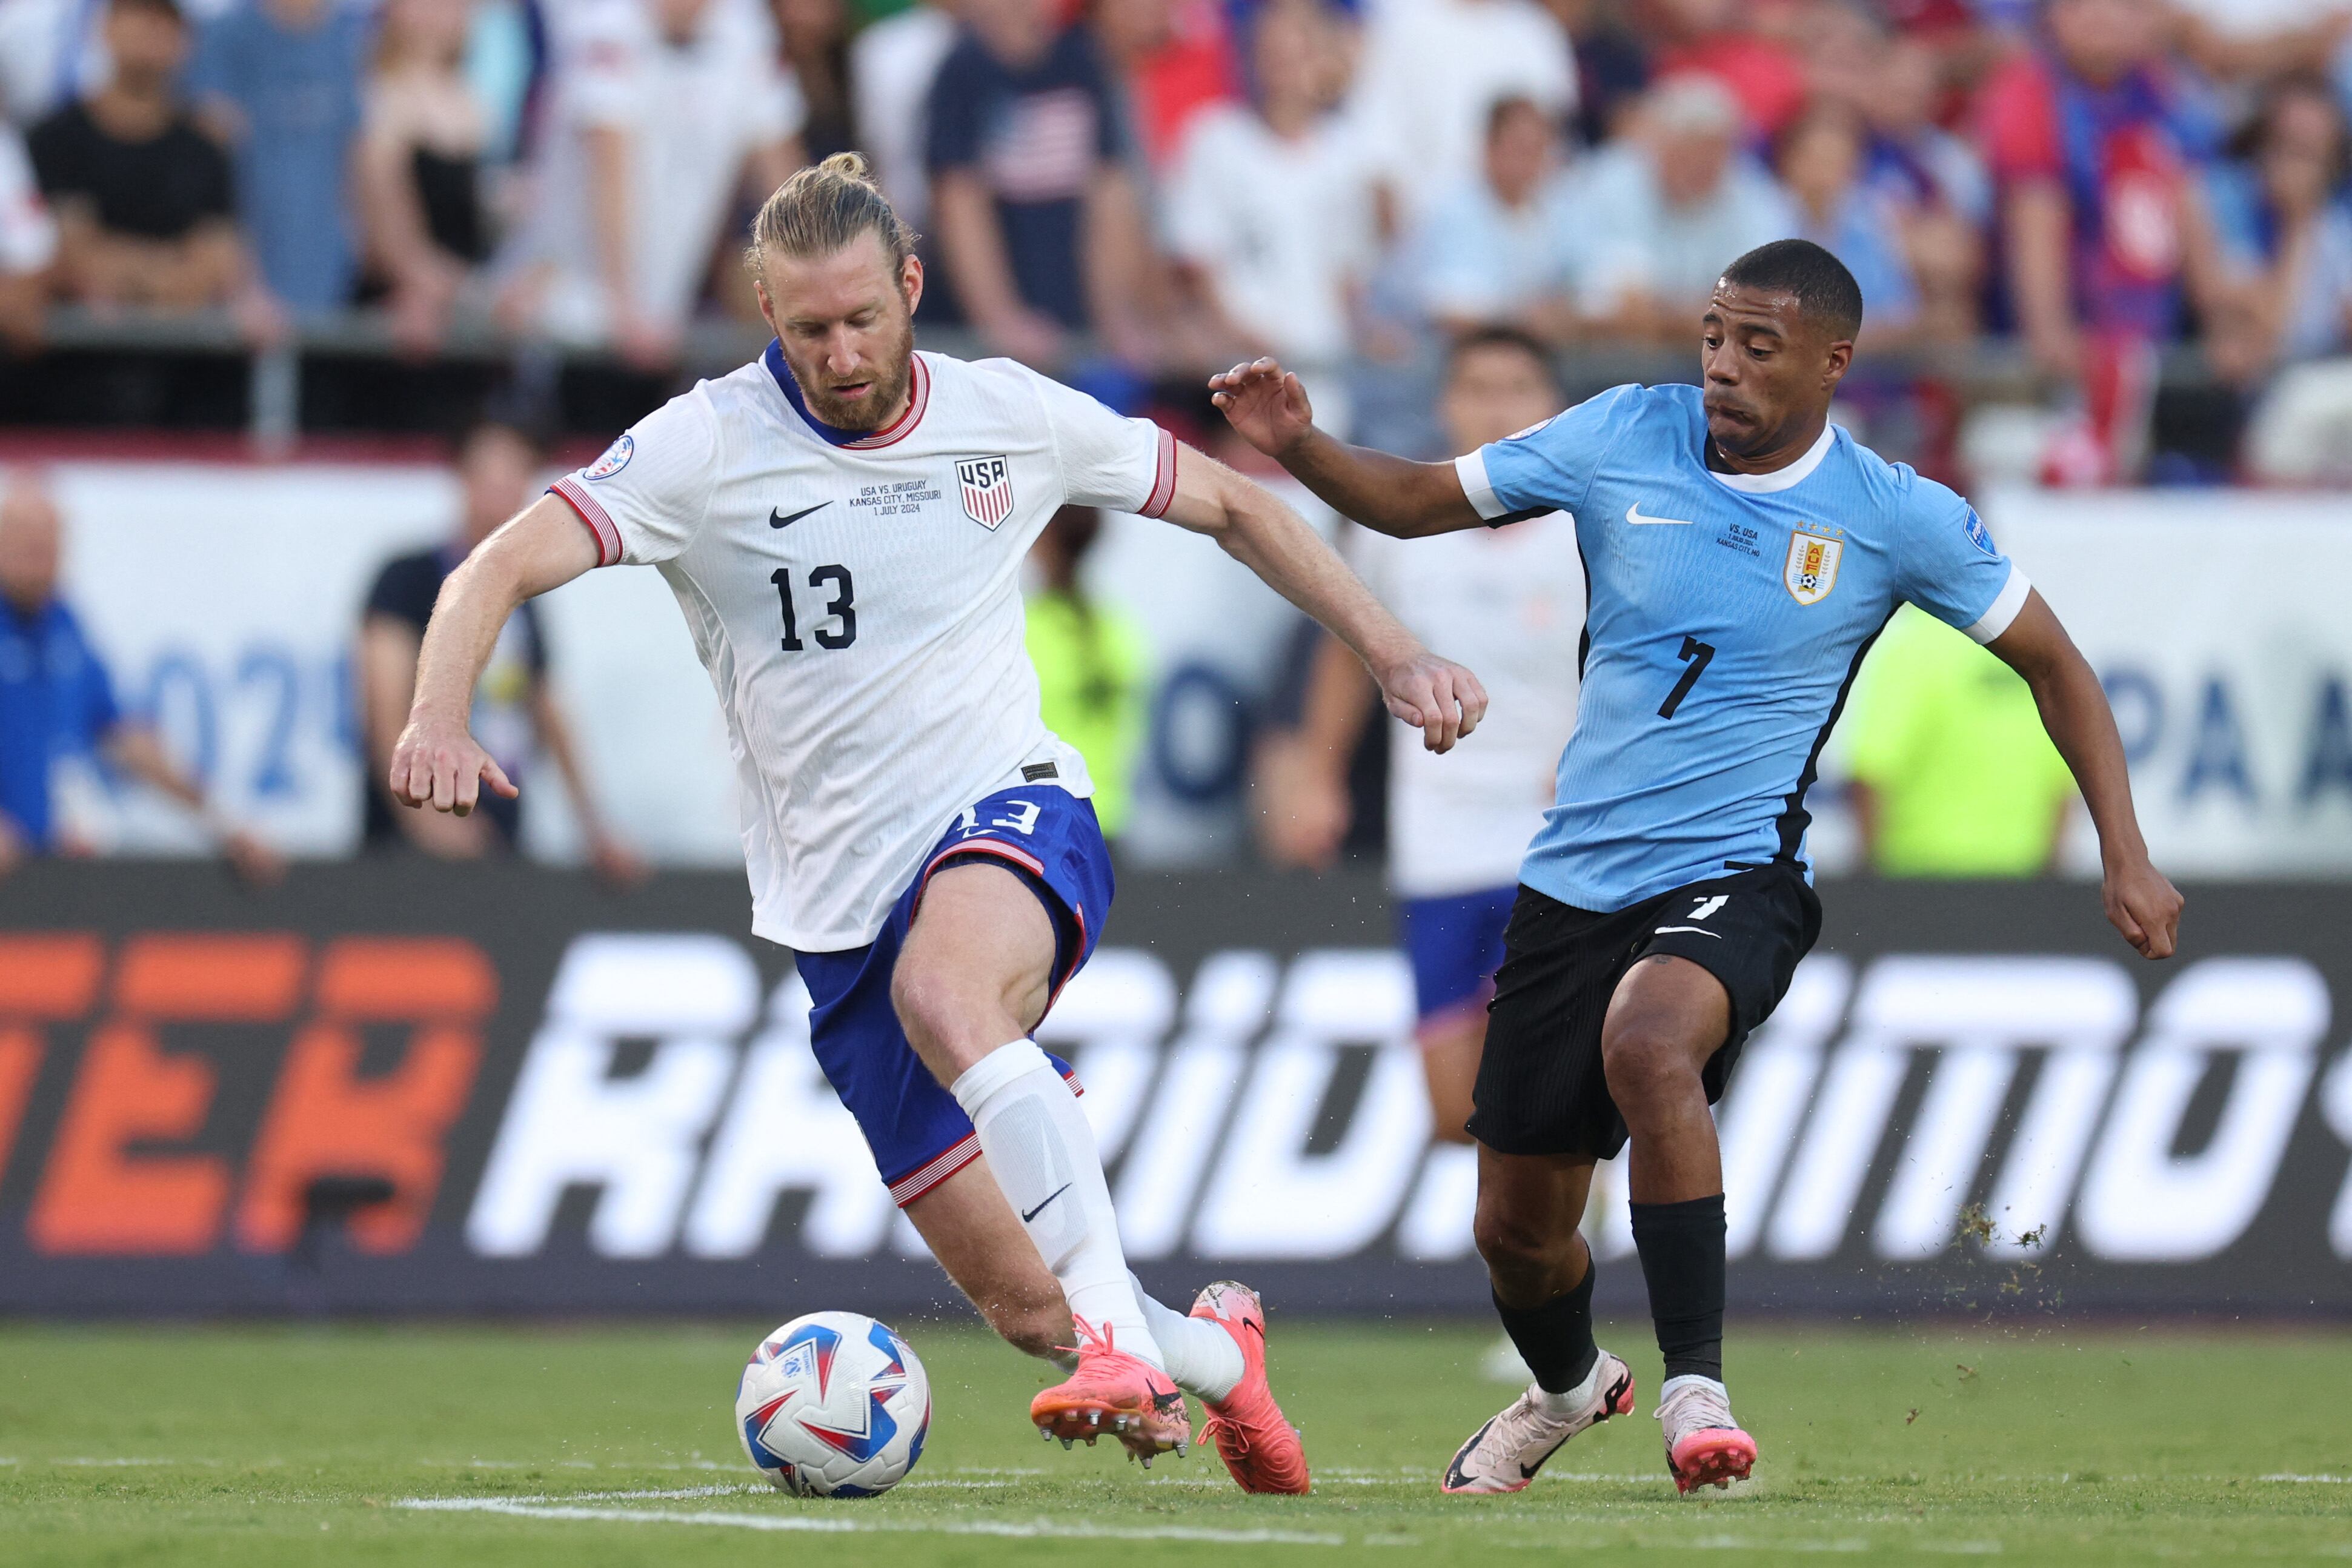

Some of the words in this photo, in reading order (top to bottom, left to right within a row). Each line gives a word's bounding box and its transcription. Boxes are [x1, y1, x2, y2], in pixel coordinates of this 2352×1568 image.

[960, 460, 1004, 489] USA
[849, 496, 882, 507] KANSAS
[906, 490, 941, 502] MISSOURI
[861, 487, 876, 496] USA
[879, 485, 891, 494] VS.
[892, 480, 926, 493] URUGUAY
[874, 507, 878, 516] 1
[880, 505, 898, 516] JULY
[901, 503, 920, 514] 2024
[1729, 523, 1740, 534] VS.
[1742, 528, 1758, 540] USA
[1716, 537, 1738, 550] KANSAS
[770, 564, 857, 651] 13
[1656, 635, 1716, 720] 7
[957, 800, 1041, 835] 13
[1686, 895, 1730, 920] 7
